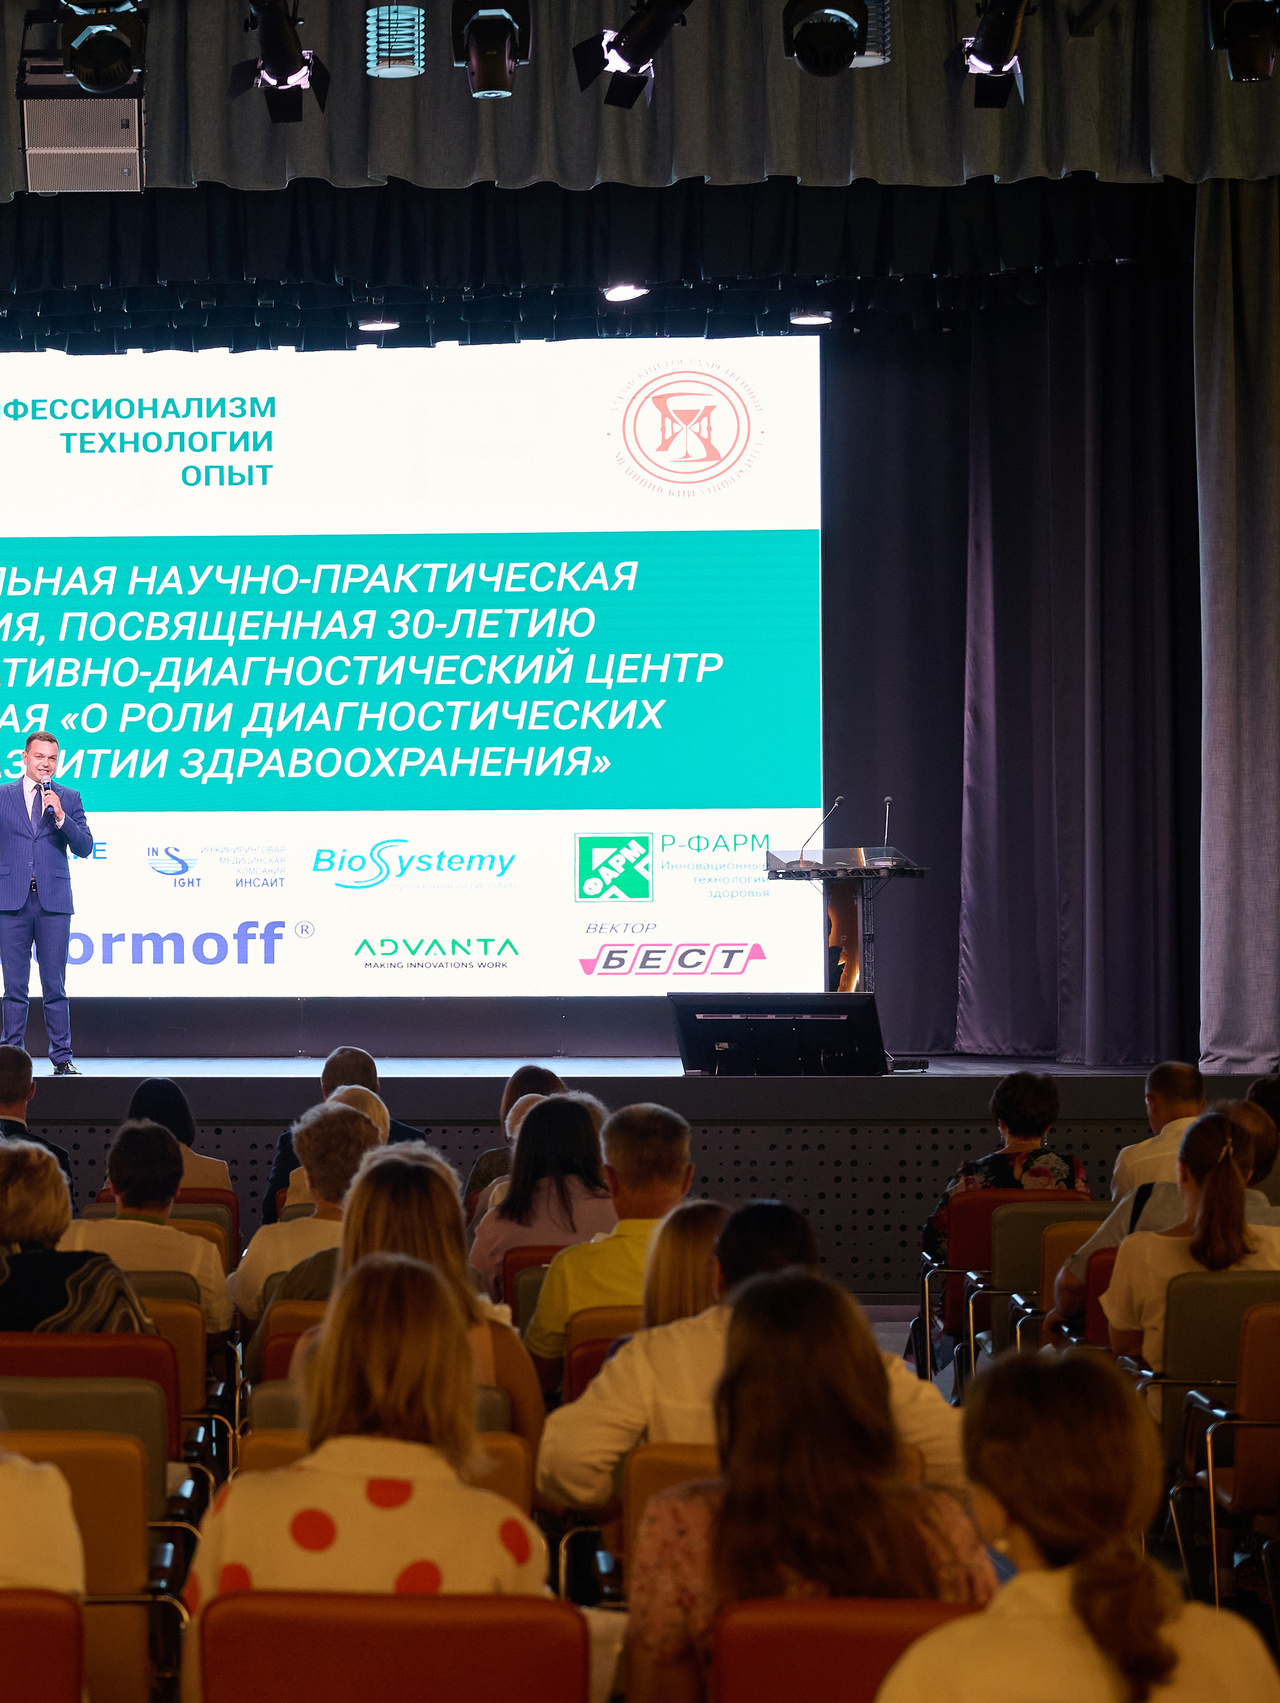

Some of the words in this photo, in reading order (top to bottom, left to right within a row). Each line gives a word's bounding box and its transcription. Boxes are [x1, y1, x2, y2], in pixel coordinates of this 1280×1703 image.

[60, 430, 273, 454] ТЕХНОЛОГИИ
[181, 464, 274, 486] ОПЫТ
[128, 562, 638, 595] НАУЧНО-ПРАКТИЧЕСКАЯ
[59, 609, 376, 646] ПОСВЯЩЕННАЯ
[388, 607, 596, 640] 30-ЛЕТИЮ
[586, 653, 724, 690] ЦЕНТР
[61, 702, 108, 733] «О
[119, 702, 233, 733] РОЛИ
[241, 699, 667, 738] ДИАГНОСТИЧЕСКИХ
[180, 746, 611, 784] ЗДРАВООХРАНЕНИЯ»
[148, 847, 158, 856] IN
[661, 834, 769, 853] Р-ФАРМ
[313, 839, 516, 889] BioSystemy
[582, 839, 647, 896] ФАРМ
[174, 878, 201, 887] IGHT
[707, 890, 769, 899] здоровья
[586, 923, 657, 934] ВЕКТОР
[354, 938, 519, 956] ADVANTA
[602, 948, 744, 970] БЕСТ
